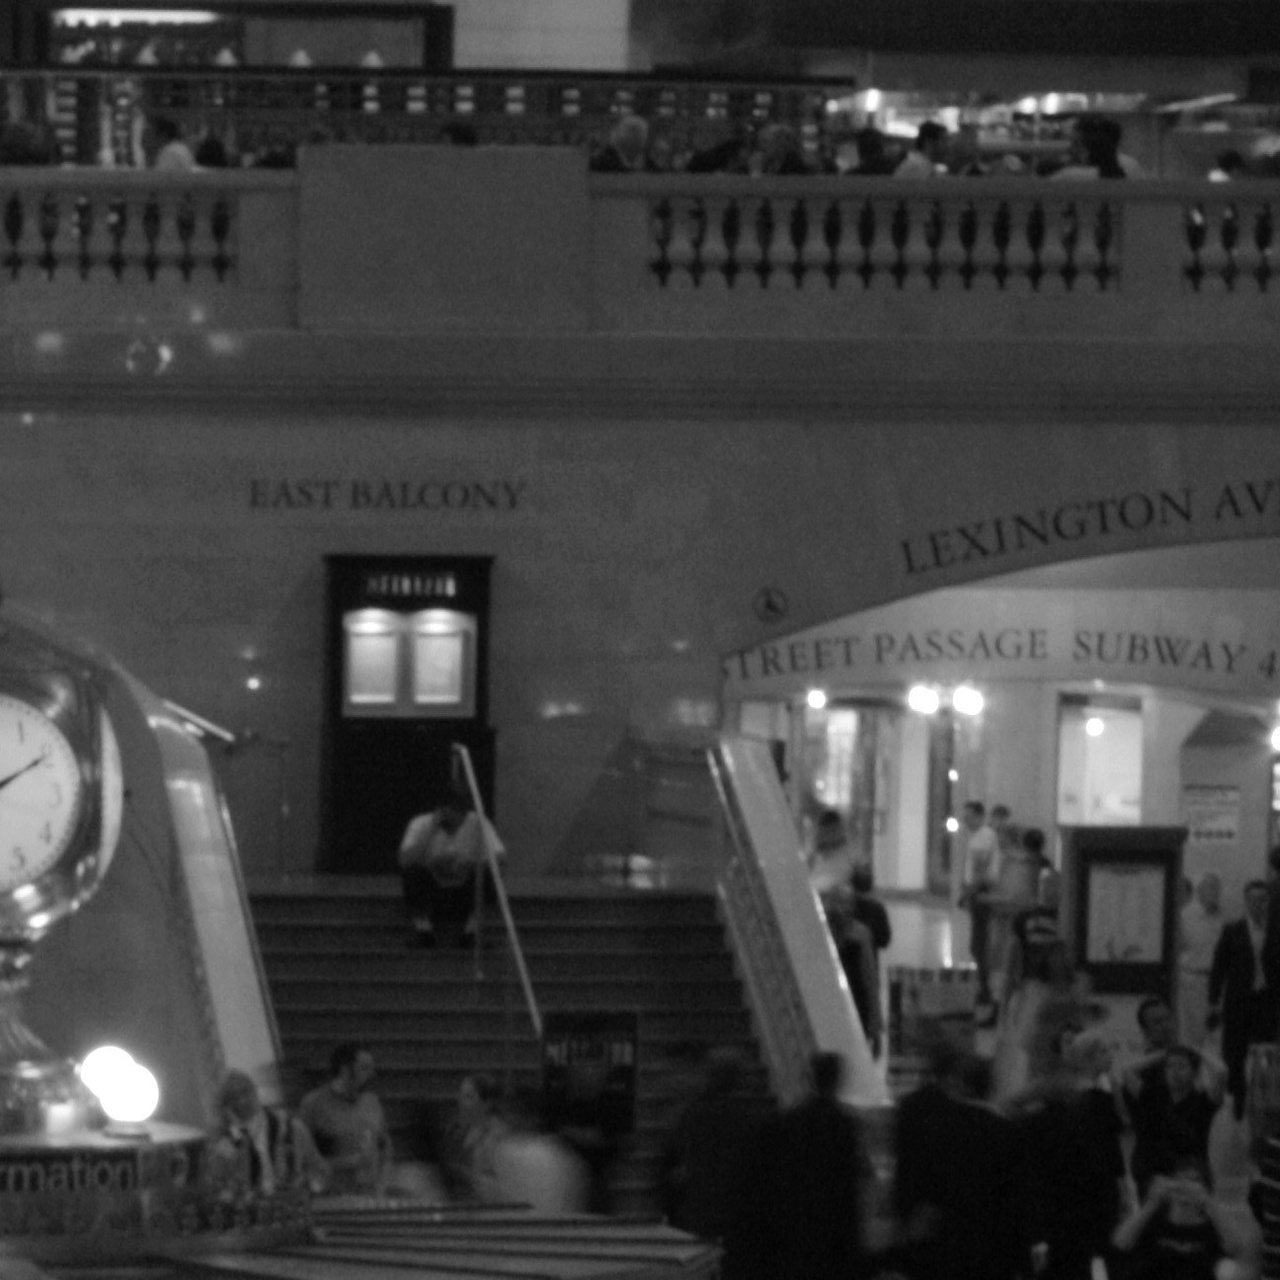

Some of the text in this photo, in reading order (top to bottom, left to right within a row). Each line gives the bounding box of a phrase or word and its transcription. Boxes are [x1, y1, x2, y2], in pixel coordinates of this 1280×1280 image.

[249, 479, 527, 511] EAST BALCONY
[900, 480, 1280, 574] LEXINGTON AV
[874, 628, 1049, 664] PASSAGE
[1072, 630, 1247, 675] SUBWAY
